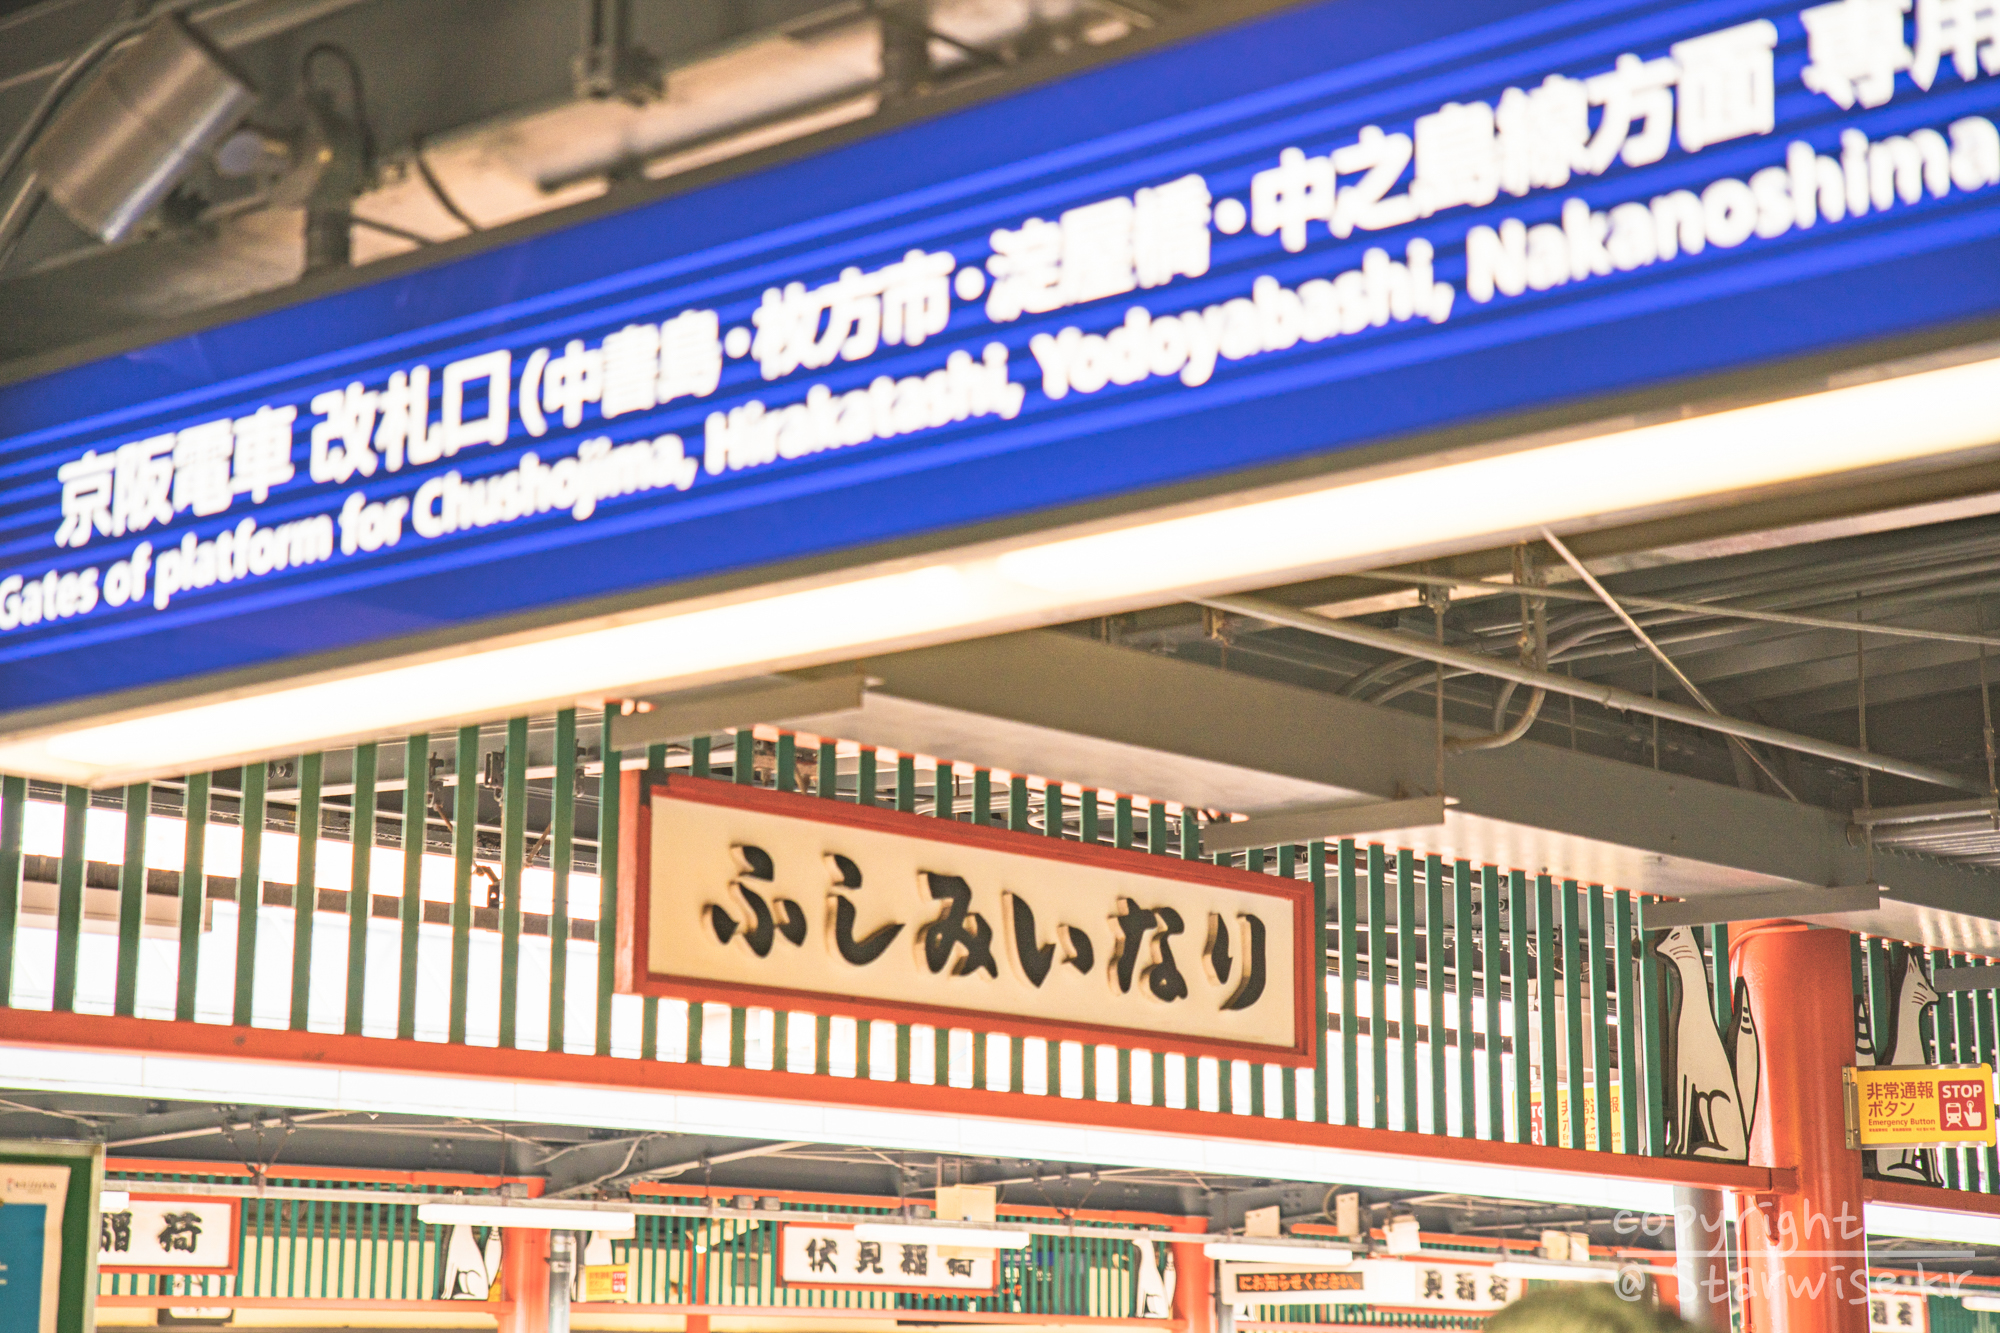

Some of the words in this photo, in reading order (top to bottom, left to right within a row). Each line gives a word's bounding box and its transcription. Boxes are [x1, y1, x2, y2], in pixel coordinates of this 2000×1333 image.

[0, 568, 99, 631] Gates
[103, 542, 153, 607] of
[153, 515, 334, 611] platform
[338, 491, 410, 556] for
[411, 434, 698, 539] Chushojima,
[704, 341, 1025, 476] Hirakatashi,
[1029, 237, 1455, 400] Yodoyabashi,
[1466, 116, 2000, 304] Nakanoshima
[55, 405, 297, 548] 京阪電車
[702, 842, 1267, 1010] ふしみいなり
[1866, 1081, 1935, 1100] 非常通報
[1942, 1084, 1982, 1099] STOP
[1868, 1100, 1915, 1118] ボタン
[1868, 1118, 1908, 1127] Emergency
[1910, 1118, 1936, 1126] Button
